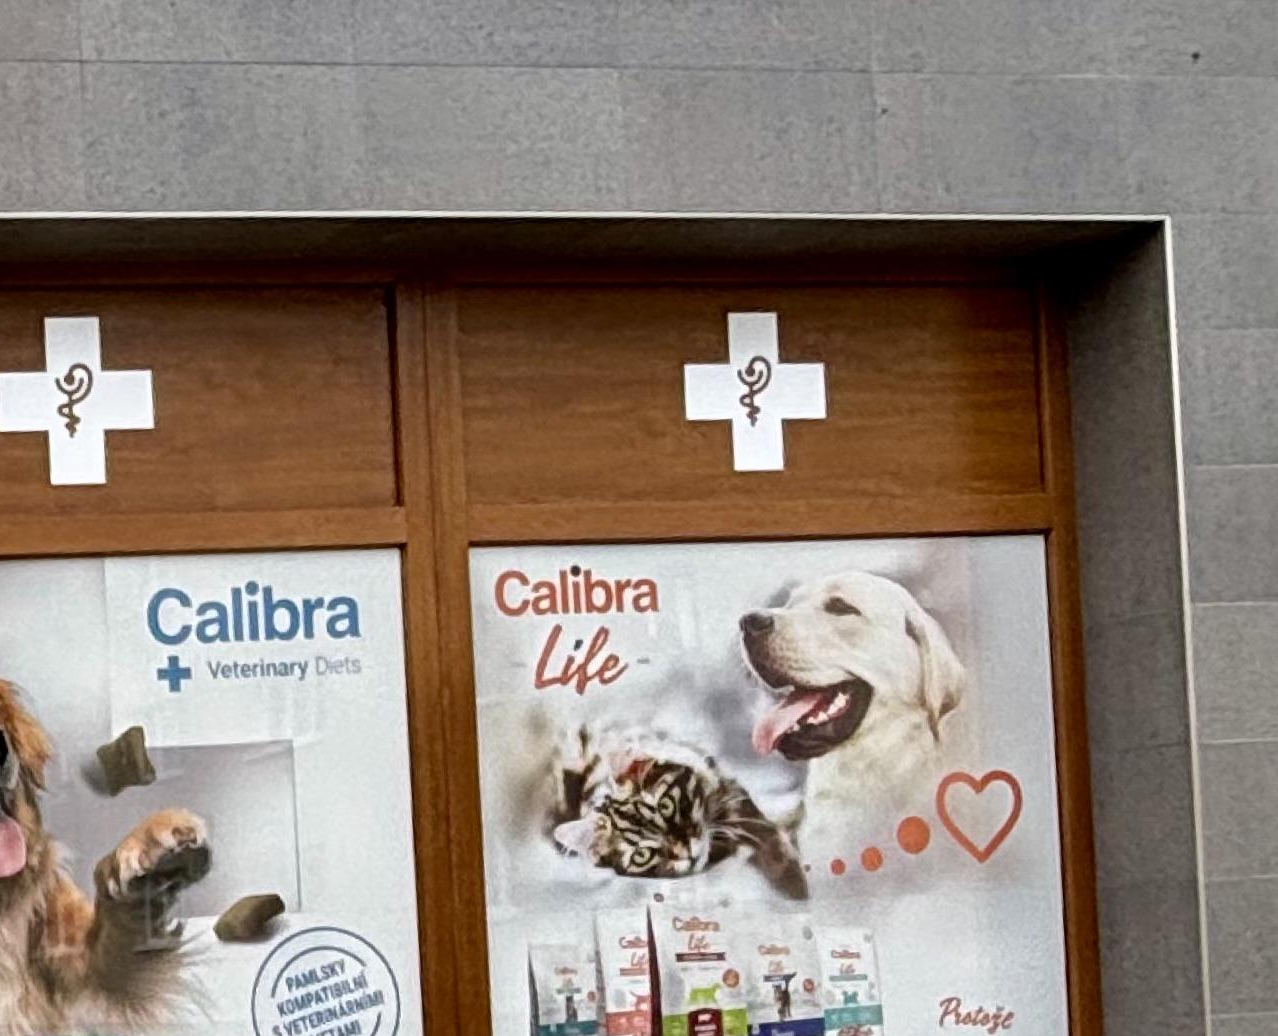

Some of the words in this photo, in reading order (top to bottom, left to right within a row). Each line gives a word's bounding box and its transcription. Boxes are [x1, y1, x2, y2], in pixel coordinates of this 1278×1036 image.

[146, 580, 362, 646] Calibra
[494, 564, 659, 617] Calibra
[208, 659, 308, 681] Veterinary
[315, 656, 362, 676] Diets
[534, 623, 629, 696] Life
[276, 969, 368, 1018] KOMPATIBILNÍ
[285, 958, 345, 992] PAMLSKY
[939, 996, 1015, 1035] Protože
